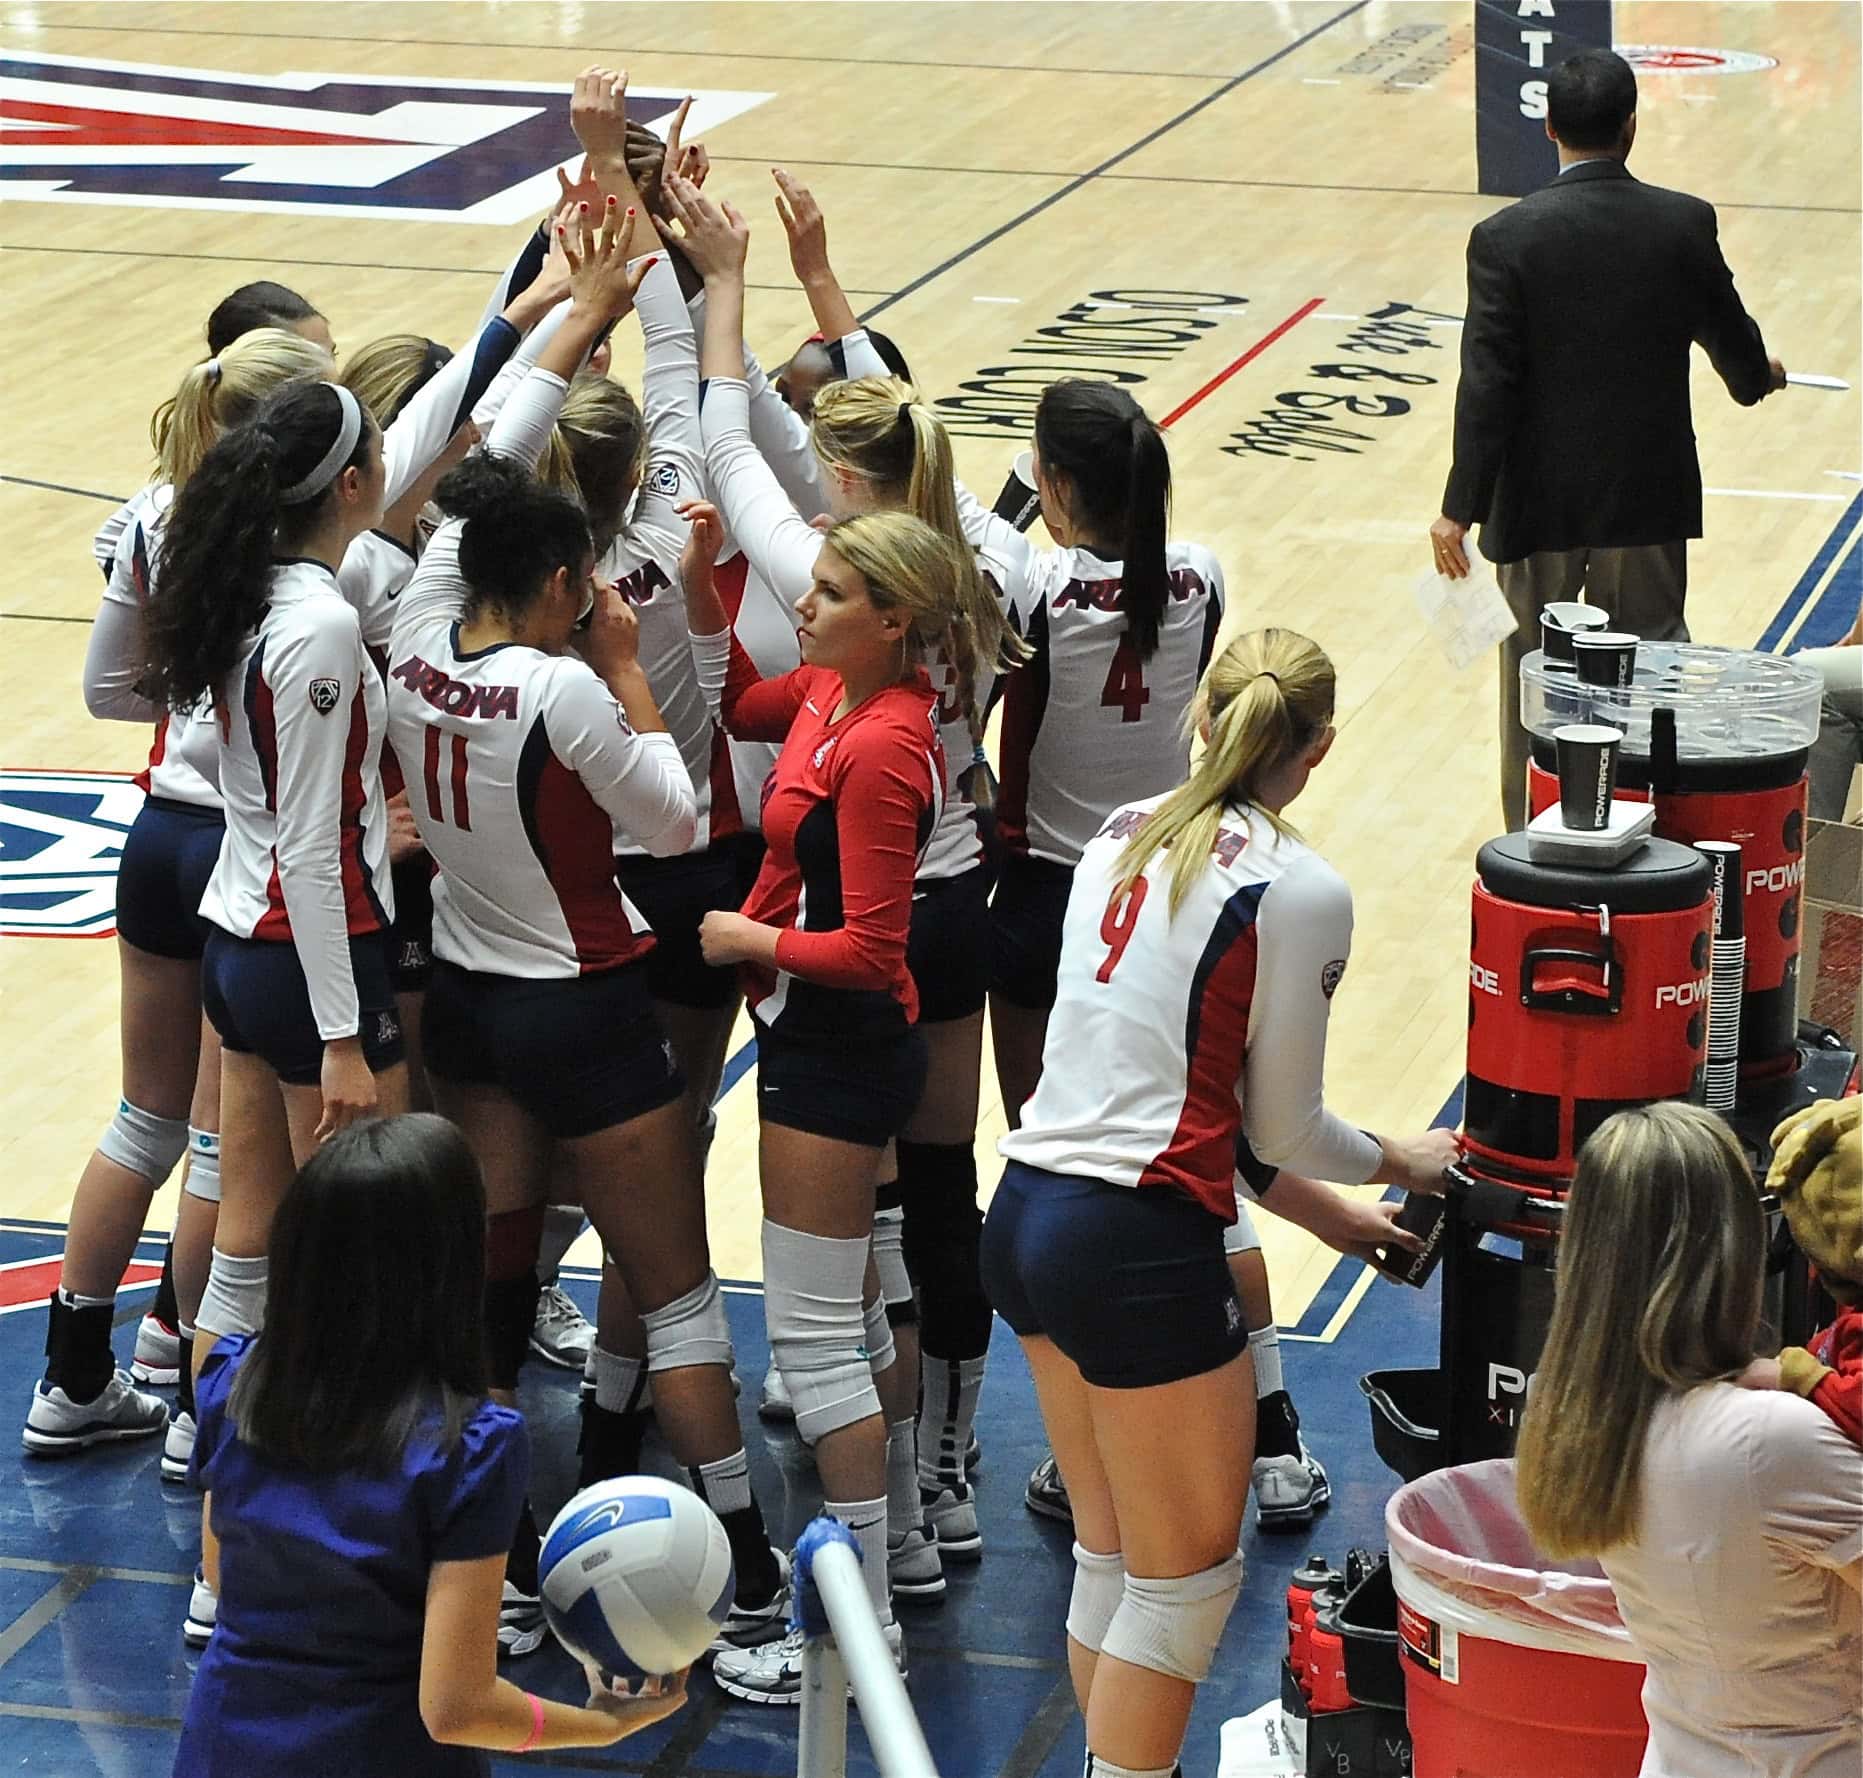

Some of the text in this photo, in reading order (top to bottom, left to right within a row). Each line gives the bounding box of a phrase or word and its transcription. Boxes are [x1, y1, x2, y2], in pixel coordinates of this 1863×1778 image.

[1008, 290, 1250, 360] OLSON
[1307, 364, 1438, 385] &
[1052, 568, 1206, 611] ARIZNA
[316, 694, 332, 708] 12
[391, 655, 519, 720] ARIZONA
[1101, 628, 1150, 722] 4
[424, 724, 472, 832] 11
[1594, 747, 1610, 827] POWERADE
[1095, 874, 1149, 984] 9
[1713, 854, 1726, 935] POWERADE
